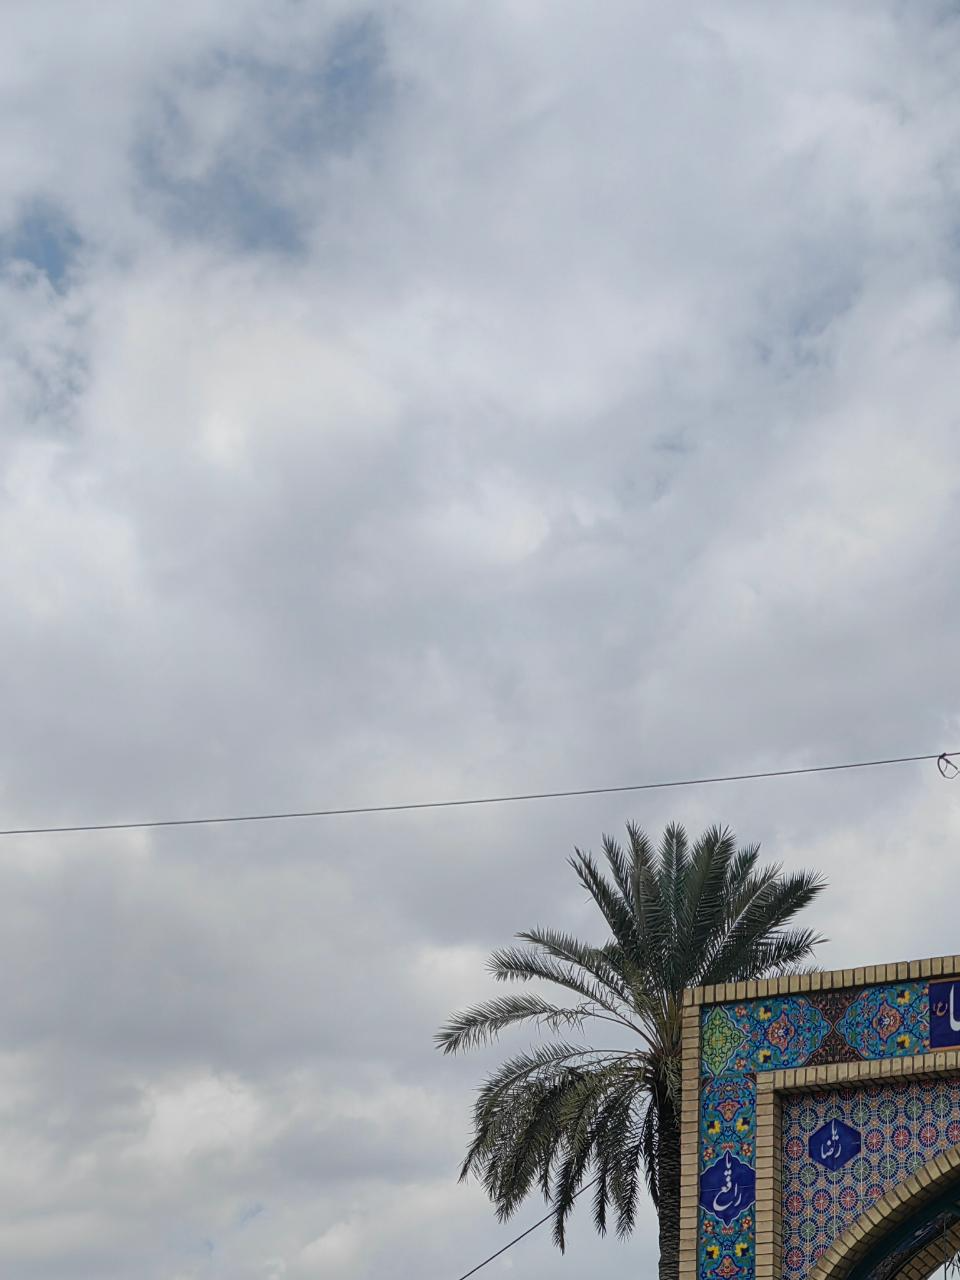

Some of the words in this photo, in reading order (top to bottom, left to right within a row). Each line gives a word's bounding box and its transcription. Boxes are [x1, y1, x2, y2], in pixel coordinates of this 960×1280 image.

[831, 1118, 840, 1141] یا
[820, 1140, 842, 1159] رضا
[723, 1151, 732, 1176] یا
[712, 1176, 742, 1212] رافع
